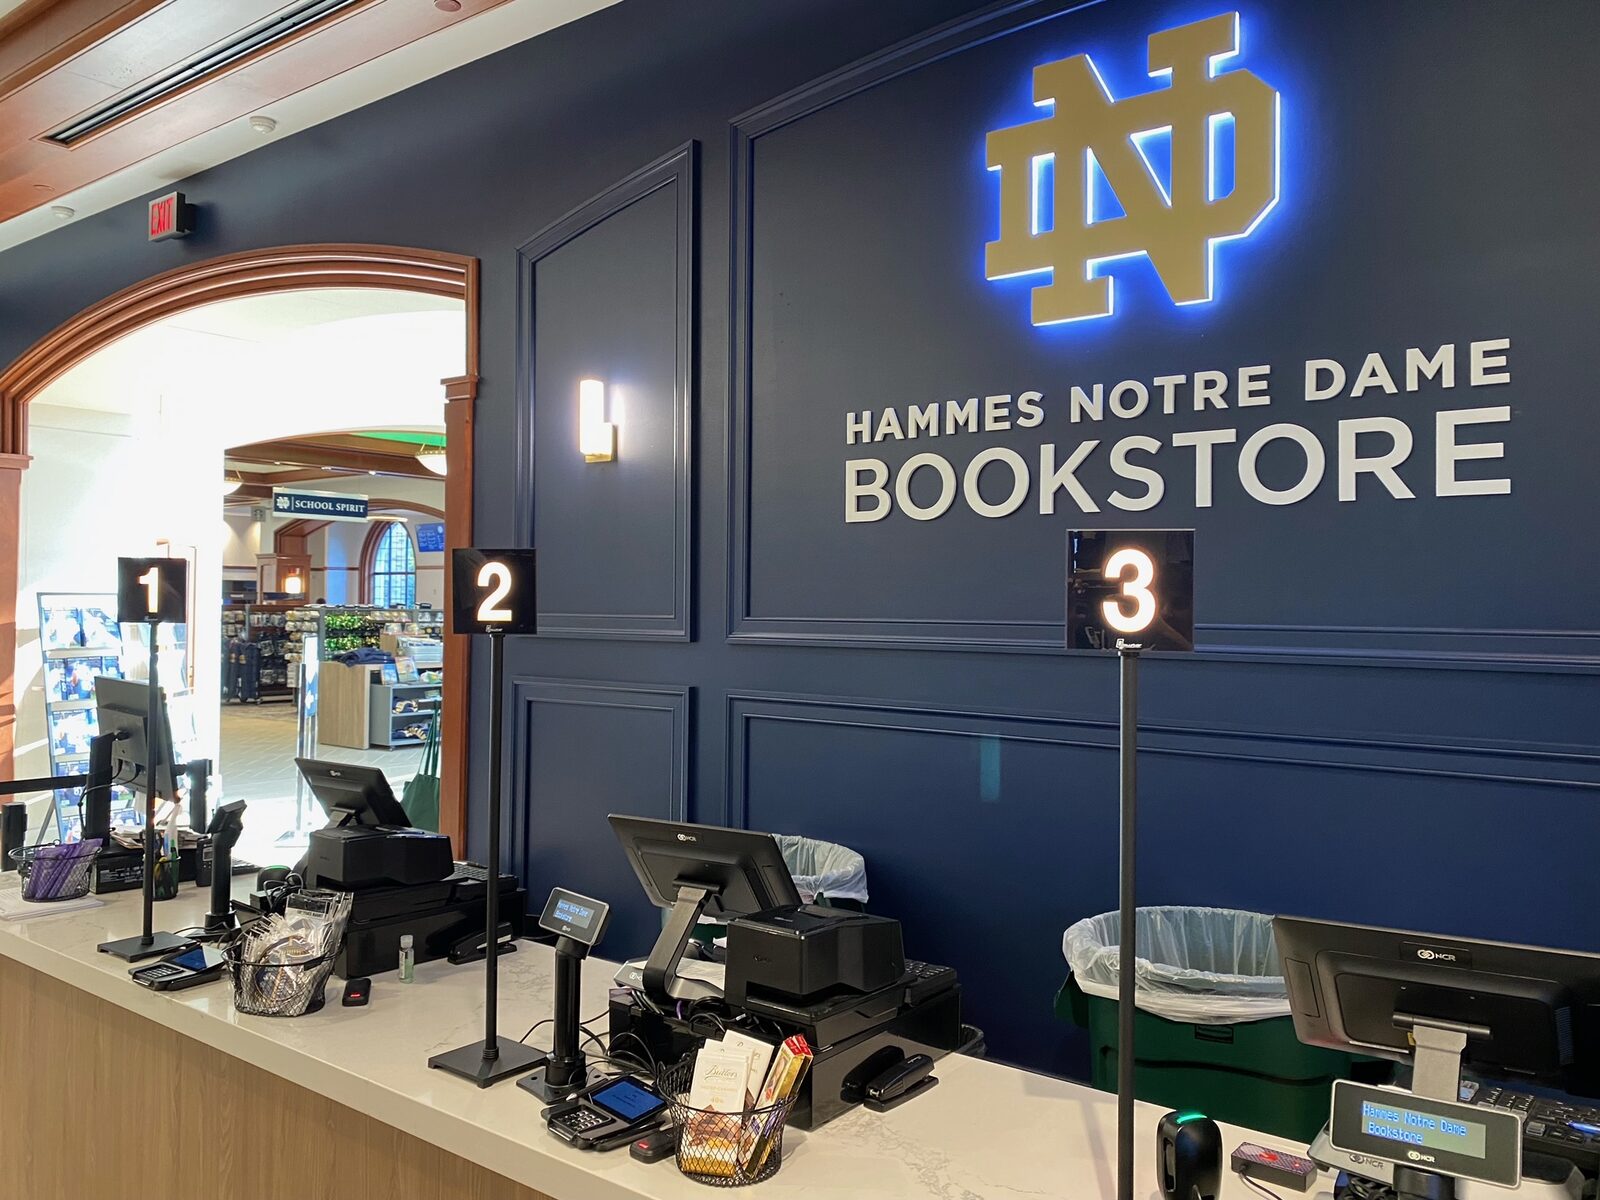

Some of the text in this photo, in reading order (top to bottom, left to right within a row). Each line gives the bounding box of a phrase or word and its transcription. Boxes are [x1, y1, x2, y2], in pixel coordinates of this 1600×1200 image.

[151, 196, 174, 236] EXIT
[846, 338, 1512, 445] HAMMES NOTRE DAME
[845, 406, 1512, 524] BOOKSTORE
[295, 499, 365, 513] SCHOOL SPIRIT
[139, 567, 159, 613] 1
[477, 561, 513, 622] 2
[1102, 547, 1156, 633] 3
[1435, 953, 1457, 962] NCR
[1368, 1122, 1424, 1145] Bookstore
[1404, 1113, 1436, 1129] Notre
[1440, 1119, 1468, 1136] Dame
[1365, 1157, 1385, 1170] NCR
[1420, 1154, 1436, 1163] NCR
